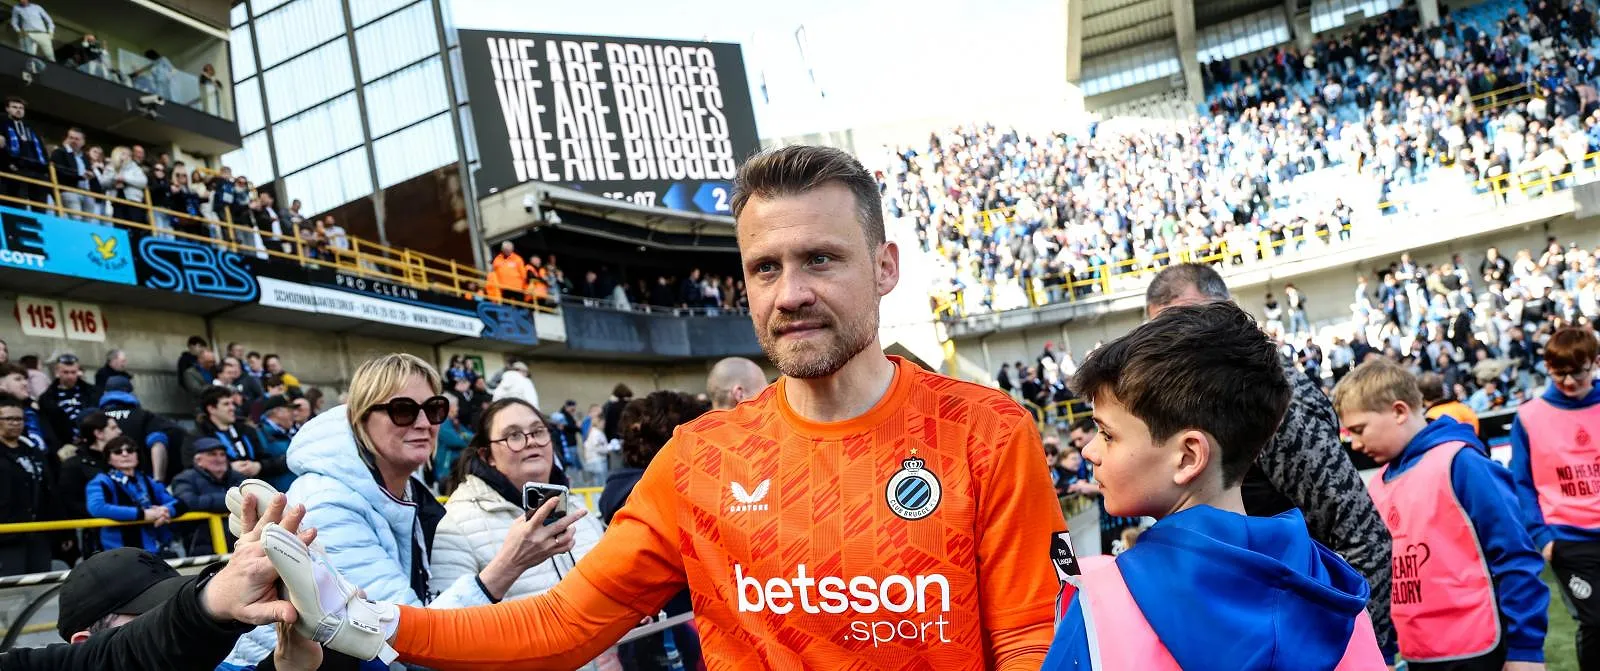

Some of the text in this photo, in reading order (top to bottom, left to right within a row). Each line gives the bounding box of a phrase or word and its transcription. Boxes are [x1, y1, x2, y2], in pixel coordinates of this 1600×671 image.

[495, 79, 730, 141] WE ARE BRUGES
[139, 235, 260, 302] SBS
[335, 274, 418, 299] PRO CLEAN
[27, 303, 97, 333] 115 116
[1556, 465, 1573, 481] NO
[1560, 482, 1576, 497] NO
[903, 506, 931, 518] BRUGGE
[735, 564, 950, 614] betsson
[843, 615, 951, 648] .sport
